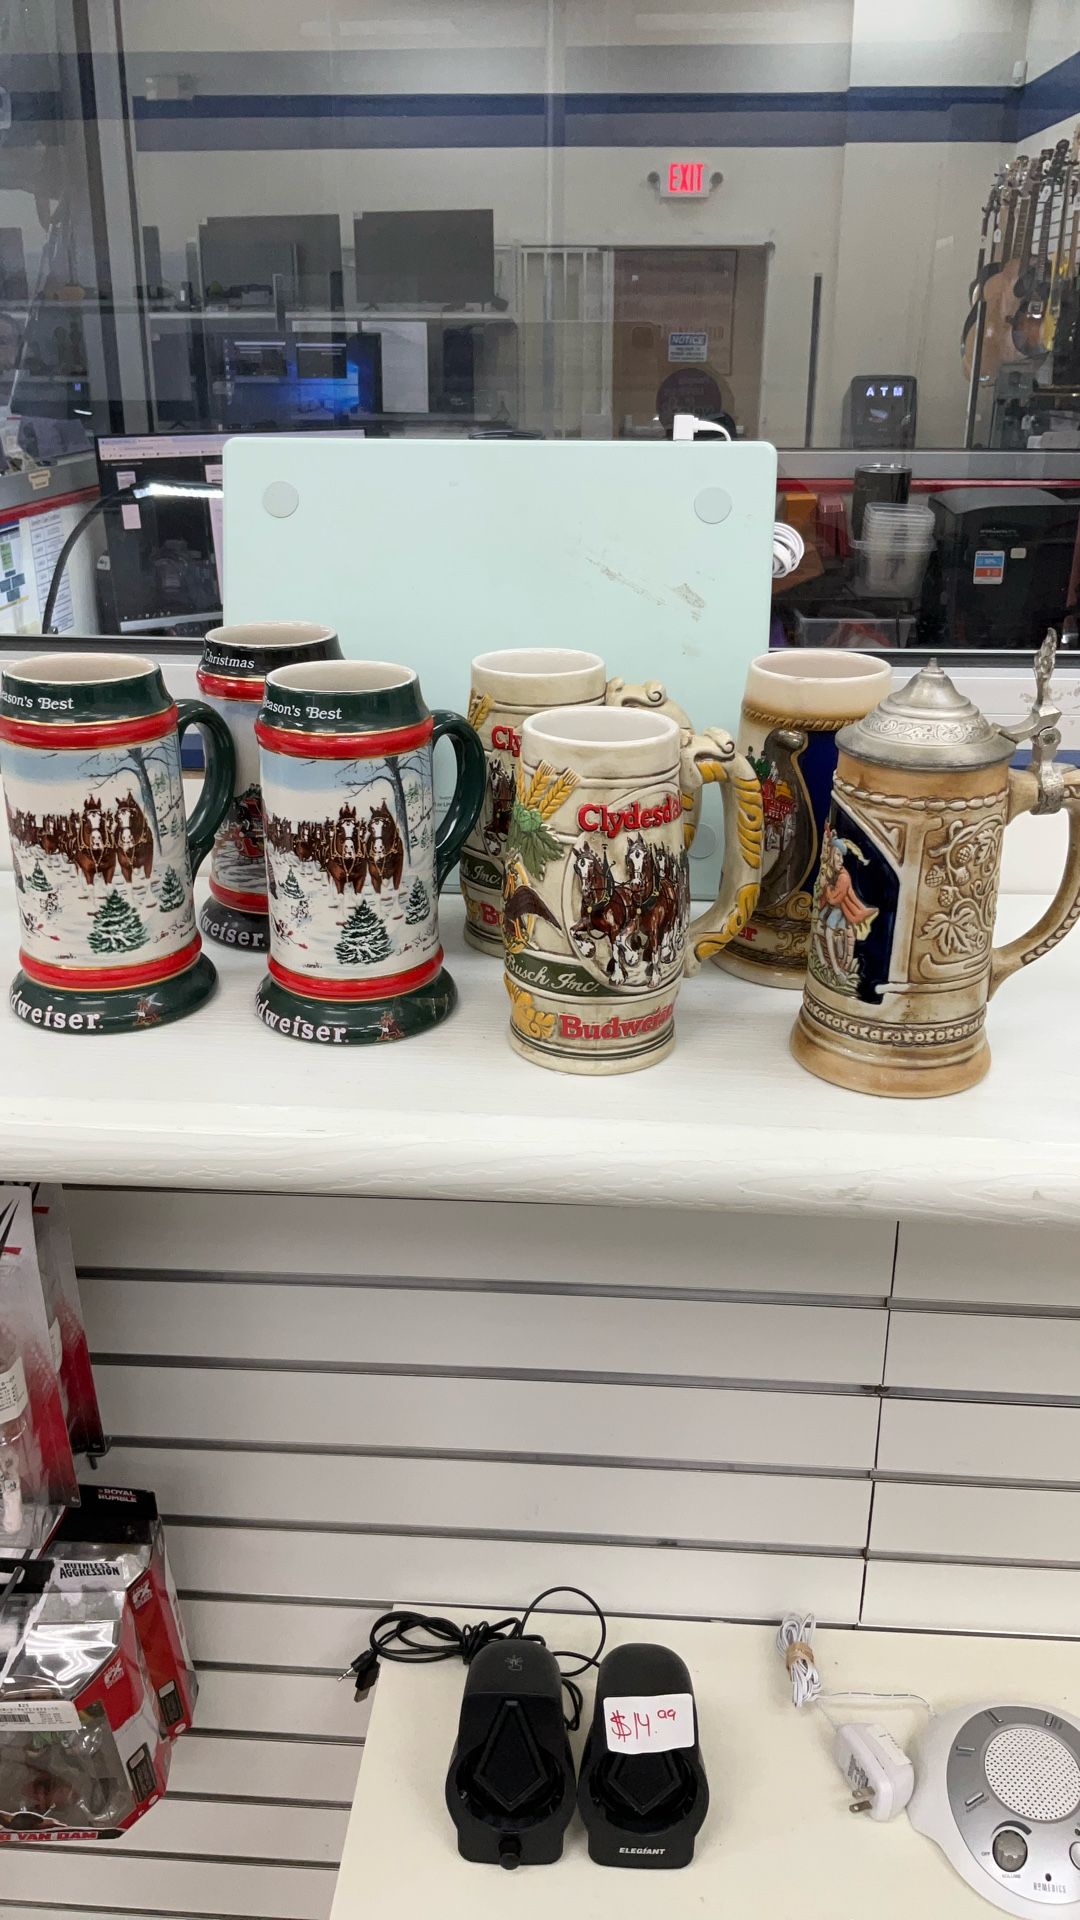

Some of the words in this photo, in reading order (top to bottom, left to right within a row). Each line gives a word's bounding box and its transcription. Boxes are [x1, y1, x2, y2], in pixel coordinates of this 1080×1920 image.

[668, 162, 704, 192] EXIT
[672, 335, 705, 345] NOTICE
[865, 386, 904, 397] ATM
[204, 648, 255, 669] Christmas
[38, 697, 75, 710] Best
[306, 706, 343, 720] Best
[60, 1566, 120, 1579] AGGRESSION
[17, 1831, 52, 1841] VAN
[56, 1831, 98, 1841] DAM
